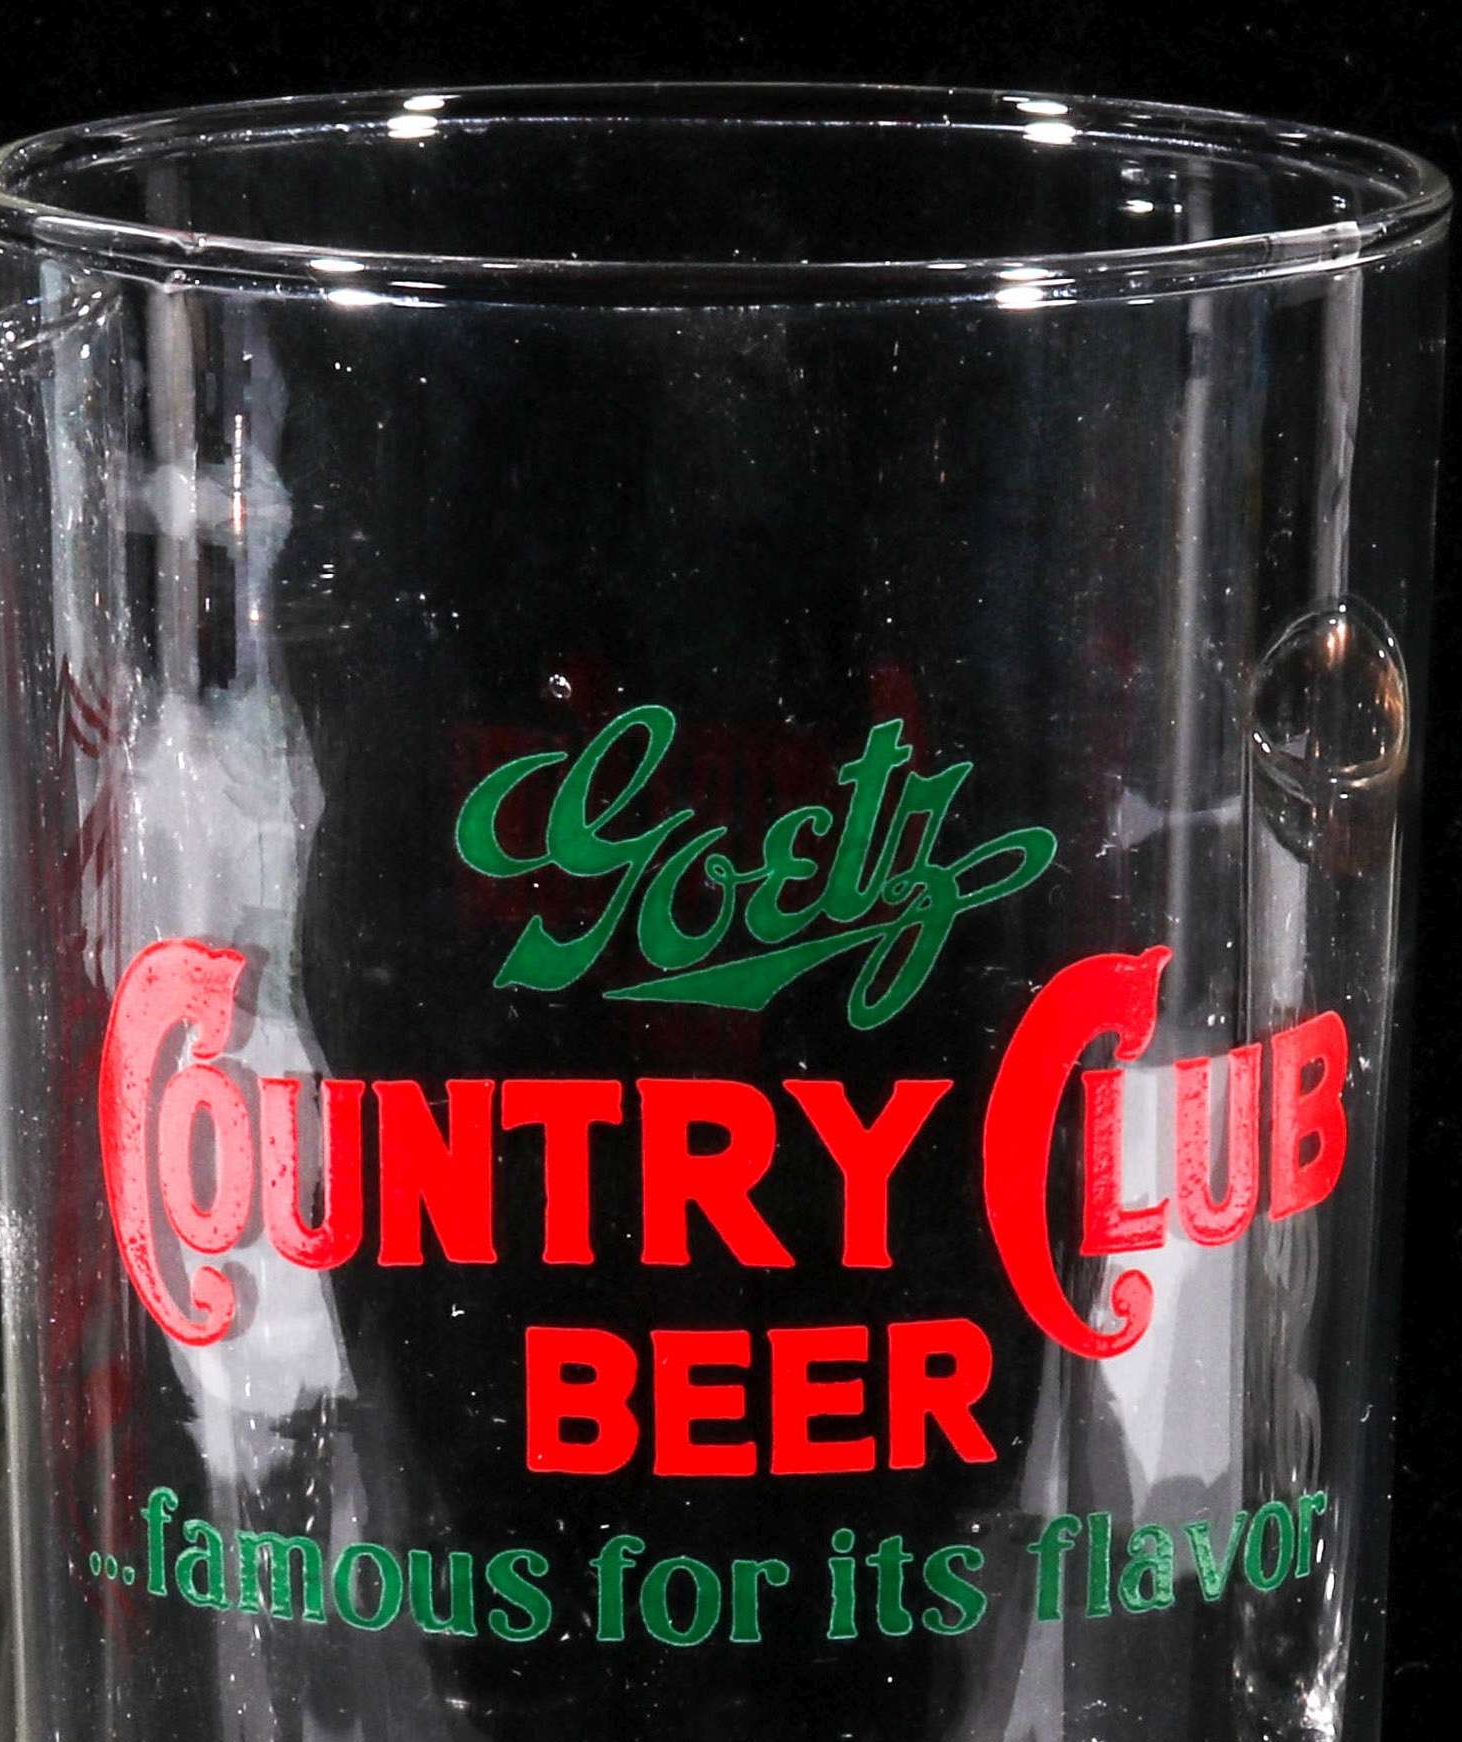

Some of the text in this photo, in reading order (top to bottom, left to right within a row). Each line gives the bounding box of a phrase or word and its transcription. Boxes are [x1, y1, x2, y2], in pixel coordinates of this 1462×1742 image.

[457, 704, 1057, 1031] Goetz
[98, 939, 1350, 1359] COUNTRY CLUB
[525, 1319, 998, 1478] BEER
[592, 1533, 792, 1647] for
[828, 1527, 987, 1641] its
[1029, 1487, 1331, 1623] flavor
